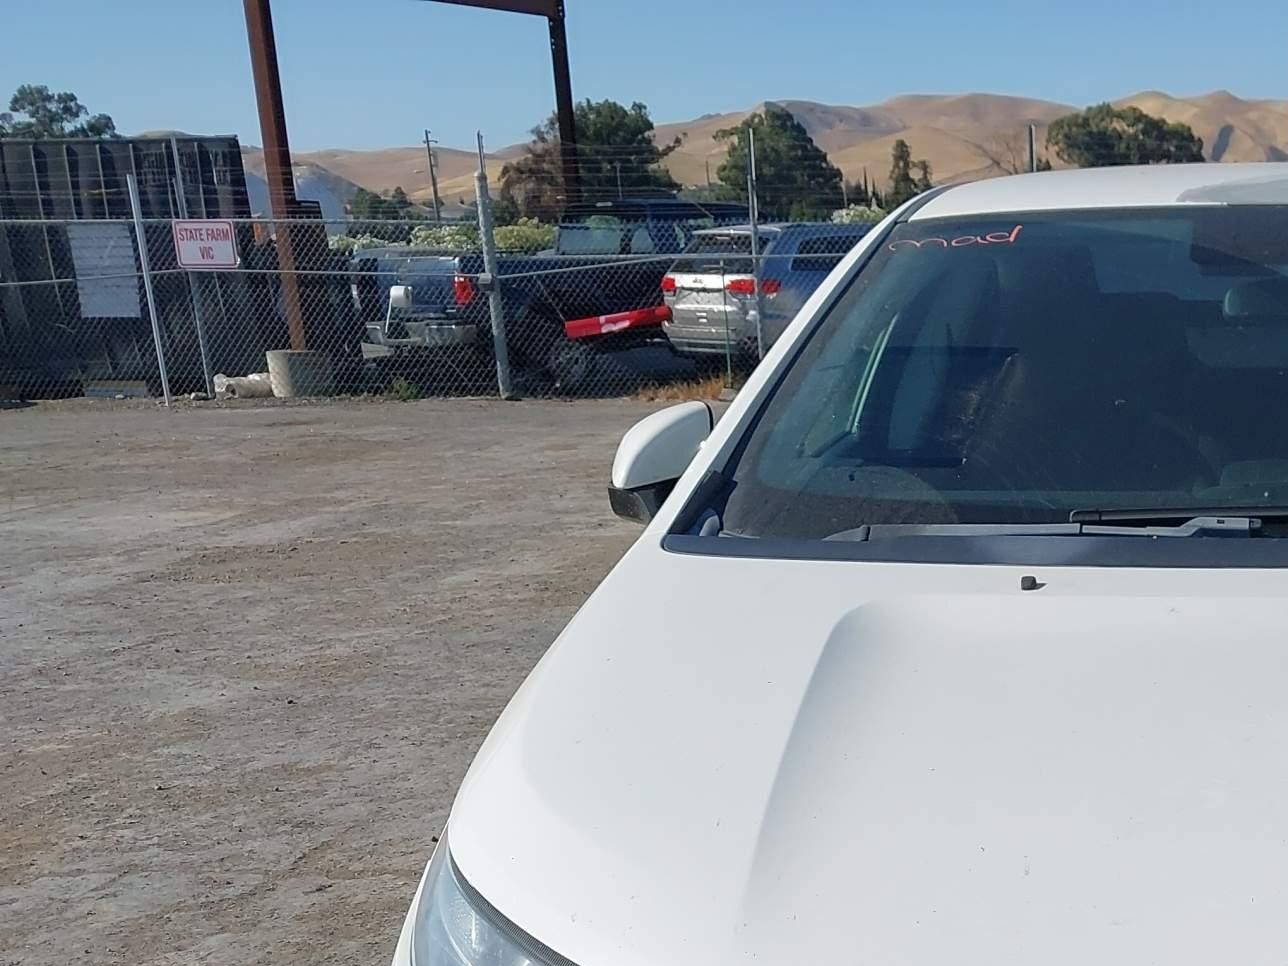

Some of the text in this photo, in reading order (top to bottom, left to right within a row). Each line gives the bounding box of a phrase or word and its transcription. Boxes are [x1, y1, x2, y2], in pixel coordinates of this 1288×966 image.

[179, 228, 230, 241] STATE FARM
[199, 246, 215, 260] VIC
